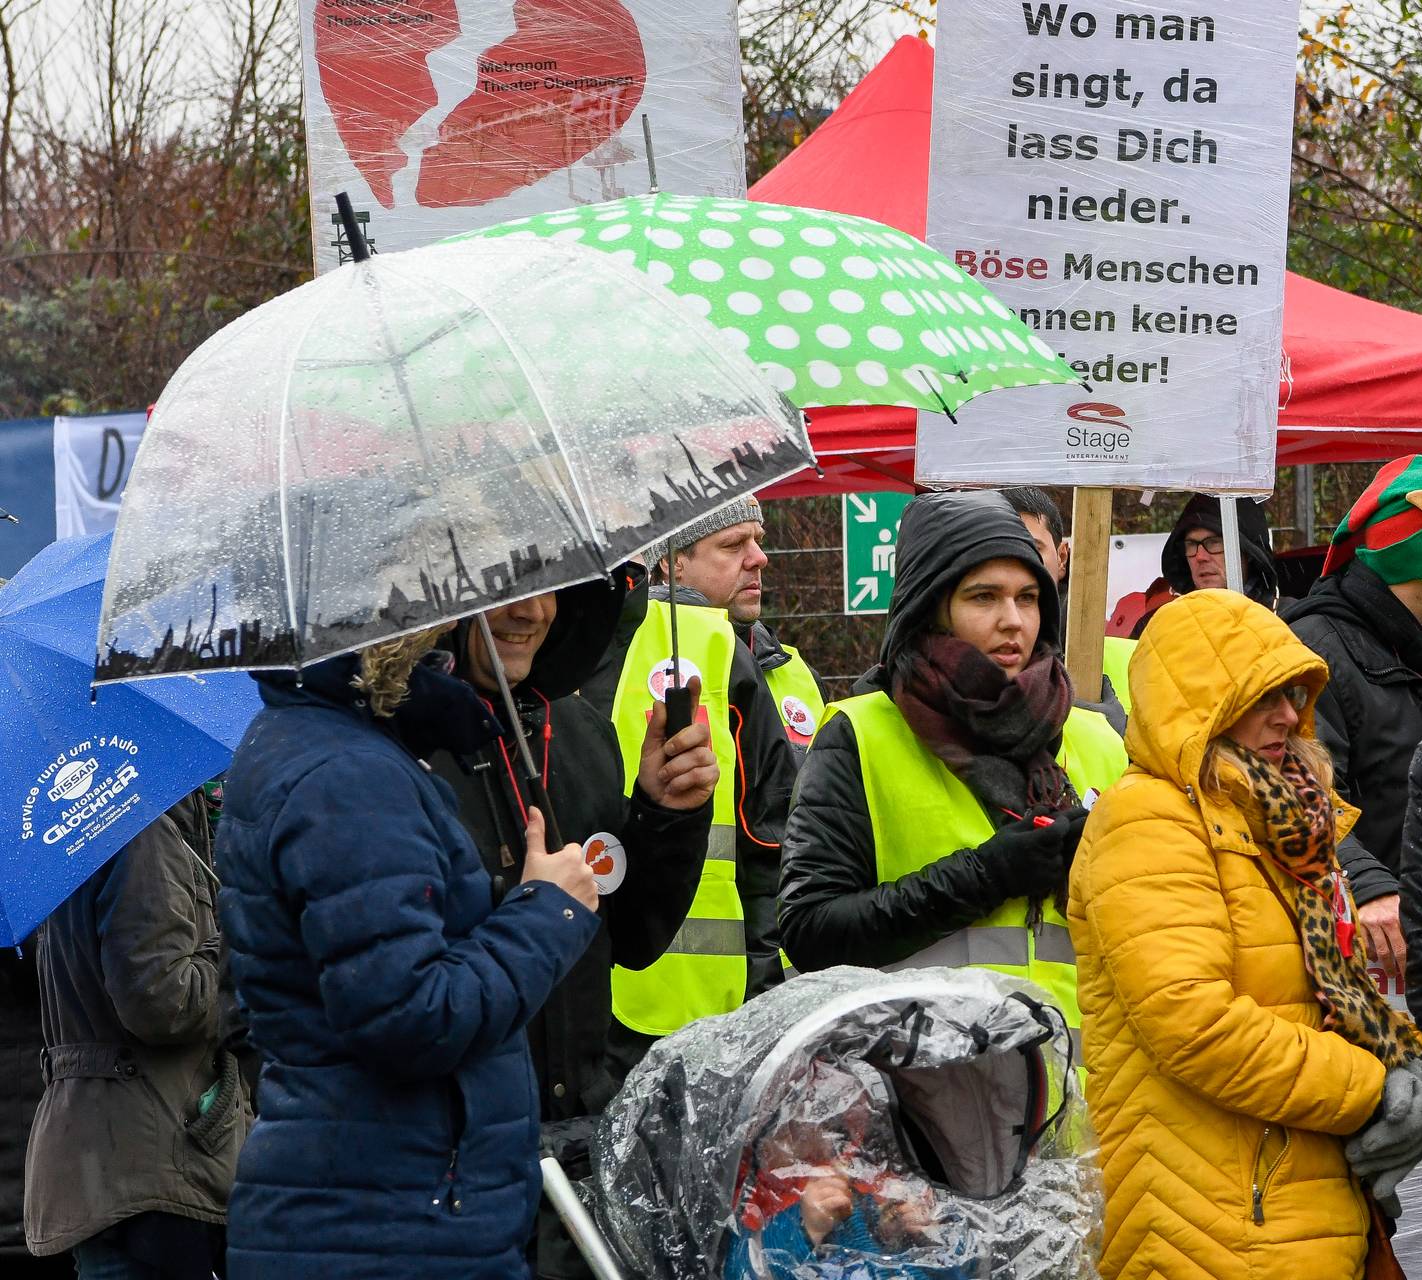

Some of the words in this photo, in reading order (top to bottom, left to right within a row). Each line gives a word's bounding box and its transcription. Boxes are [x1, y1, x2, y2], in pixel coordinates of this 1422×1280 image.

[326, 15, 383, 28] Theater
[1022, 2, 1097, 38] Wo
[1115, 11, 1215, 42] man
[480, 59, 558, 73] Metronom
[482, 78, 538, 93] Theater
[543, 74, 634, 90] Oberhausen
[1011, 63, 1144, 109] singt,
[1163, 69, 1218, 104] da
[1007, 124, 1099, 162] lass
[1117, 128, 1217, 164] Dich
[1027, 186, 1191, 225] nieder.
[955, 249, 1049, 280] Böse
[1063, 252, 1258, 286] Menschen
[1132, 304, 1238, 335] keine
[1066, 427, 1130, 452] Stage
[97, 428, 126, 500] D
[21, 786, 40, 840] Service
[37, 753, 67, 784] rund
[109, 734, 138, 755] Auto
[50, 760, 97, 800] NISSAN
[61, 776, 113, 820] Autohaus
